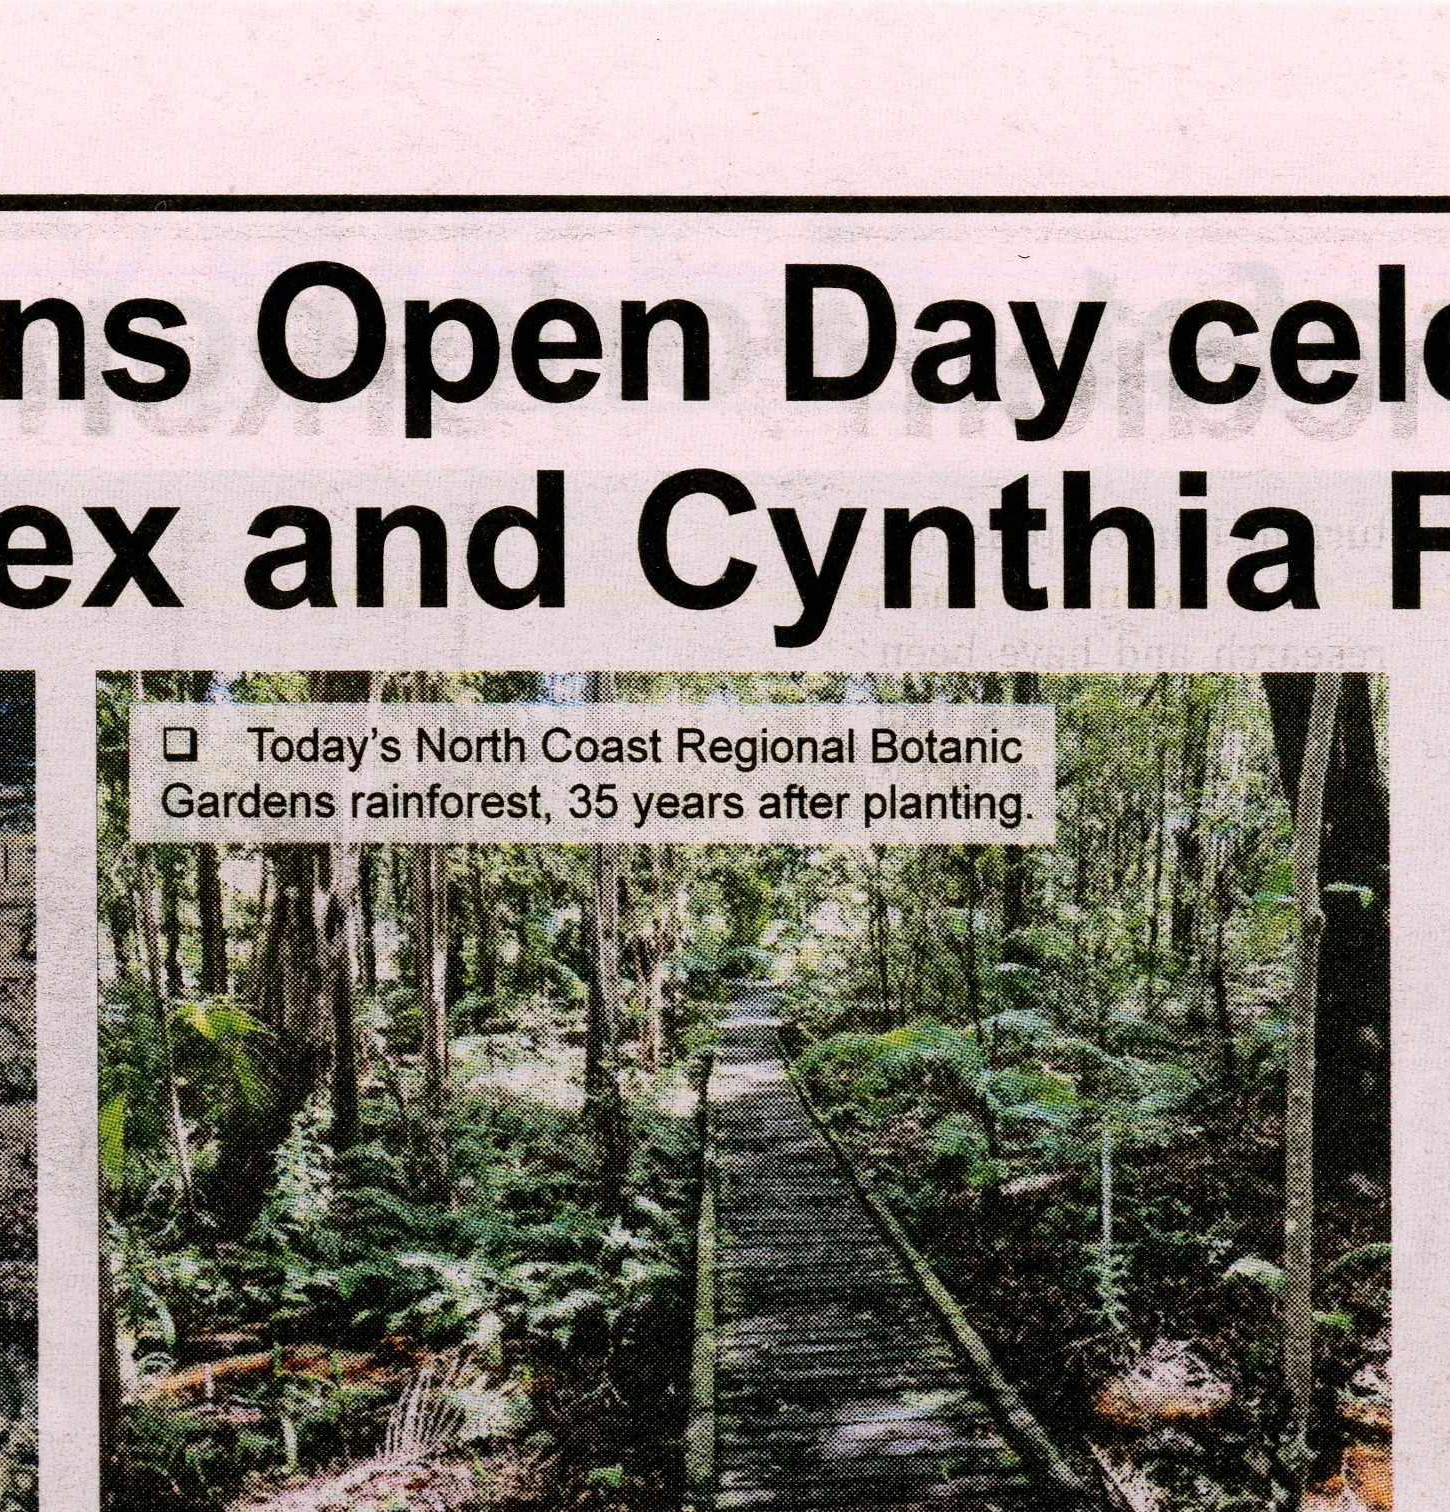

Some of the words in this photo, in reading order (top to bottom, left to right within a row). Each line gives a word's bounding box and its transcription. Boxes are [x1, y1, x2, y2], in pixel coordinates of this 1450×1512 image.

[256, 260, 711, 439] Open
[784, 263, 1107, 442] Day
[243, 469, 566, 611] and
[637, 467, 1321, 649] Cynthia
[160, 781, 336, 819] Gardens
[351, 782, 552, 825] rainforest,
[569, 783, 619, 820] 35
[632, 792, 745, 829] years
[758, 783, 851, 820] after
[864, 783, 1033, 830] planting.
[246, 726, 402, 773] Today’s
[416, 726, 527, 764] North
[541, 726, 662, 764] Coast
[677, 727, 855, 773] Regional
[871, 727, 1023, 764] Botanic
